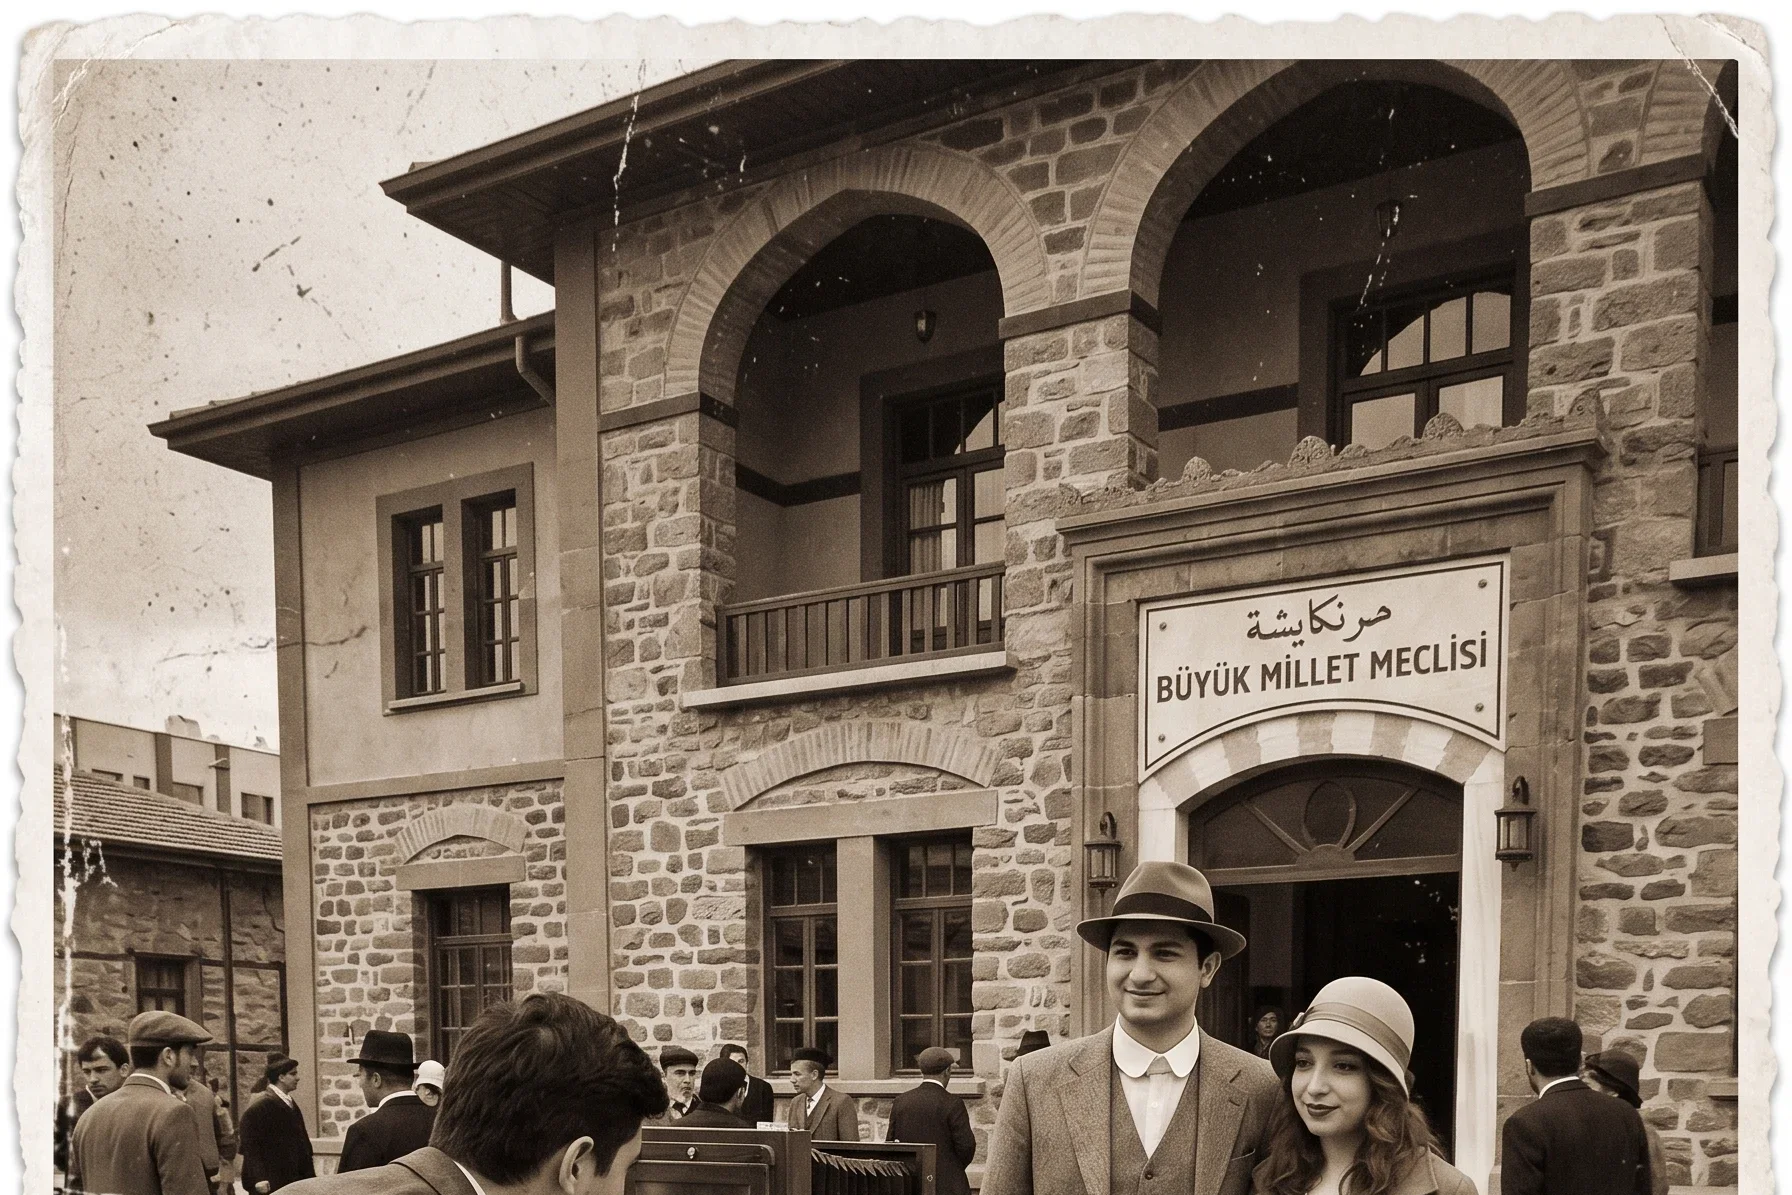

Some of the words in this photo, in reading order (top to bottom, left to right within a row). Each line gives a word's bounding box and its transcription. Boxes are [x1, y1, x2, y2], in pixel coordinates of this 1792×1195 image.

[1156, 661, 1251, 704] BÜYÜK
[1260, 652, 1360, 692] MİLLET
[1370, 630, 1487, 680] MECLİSİ
